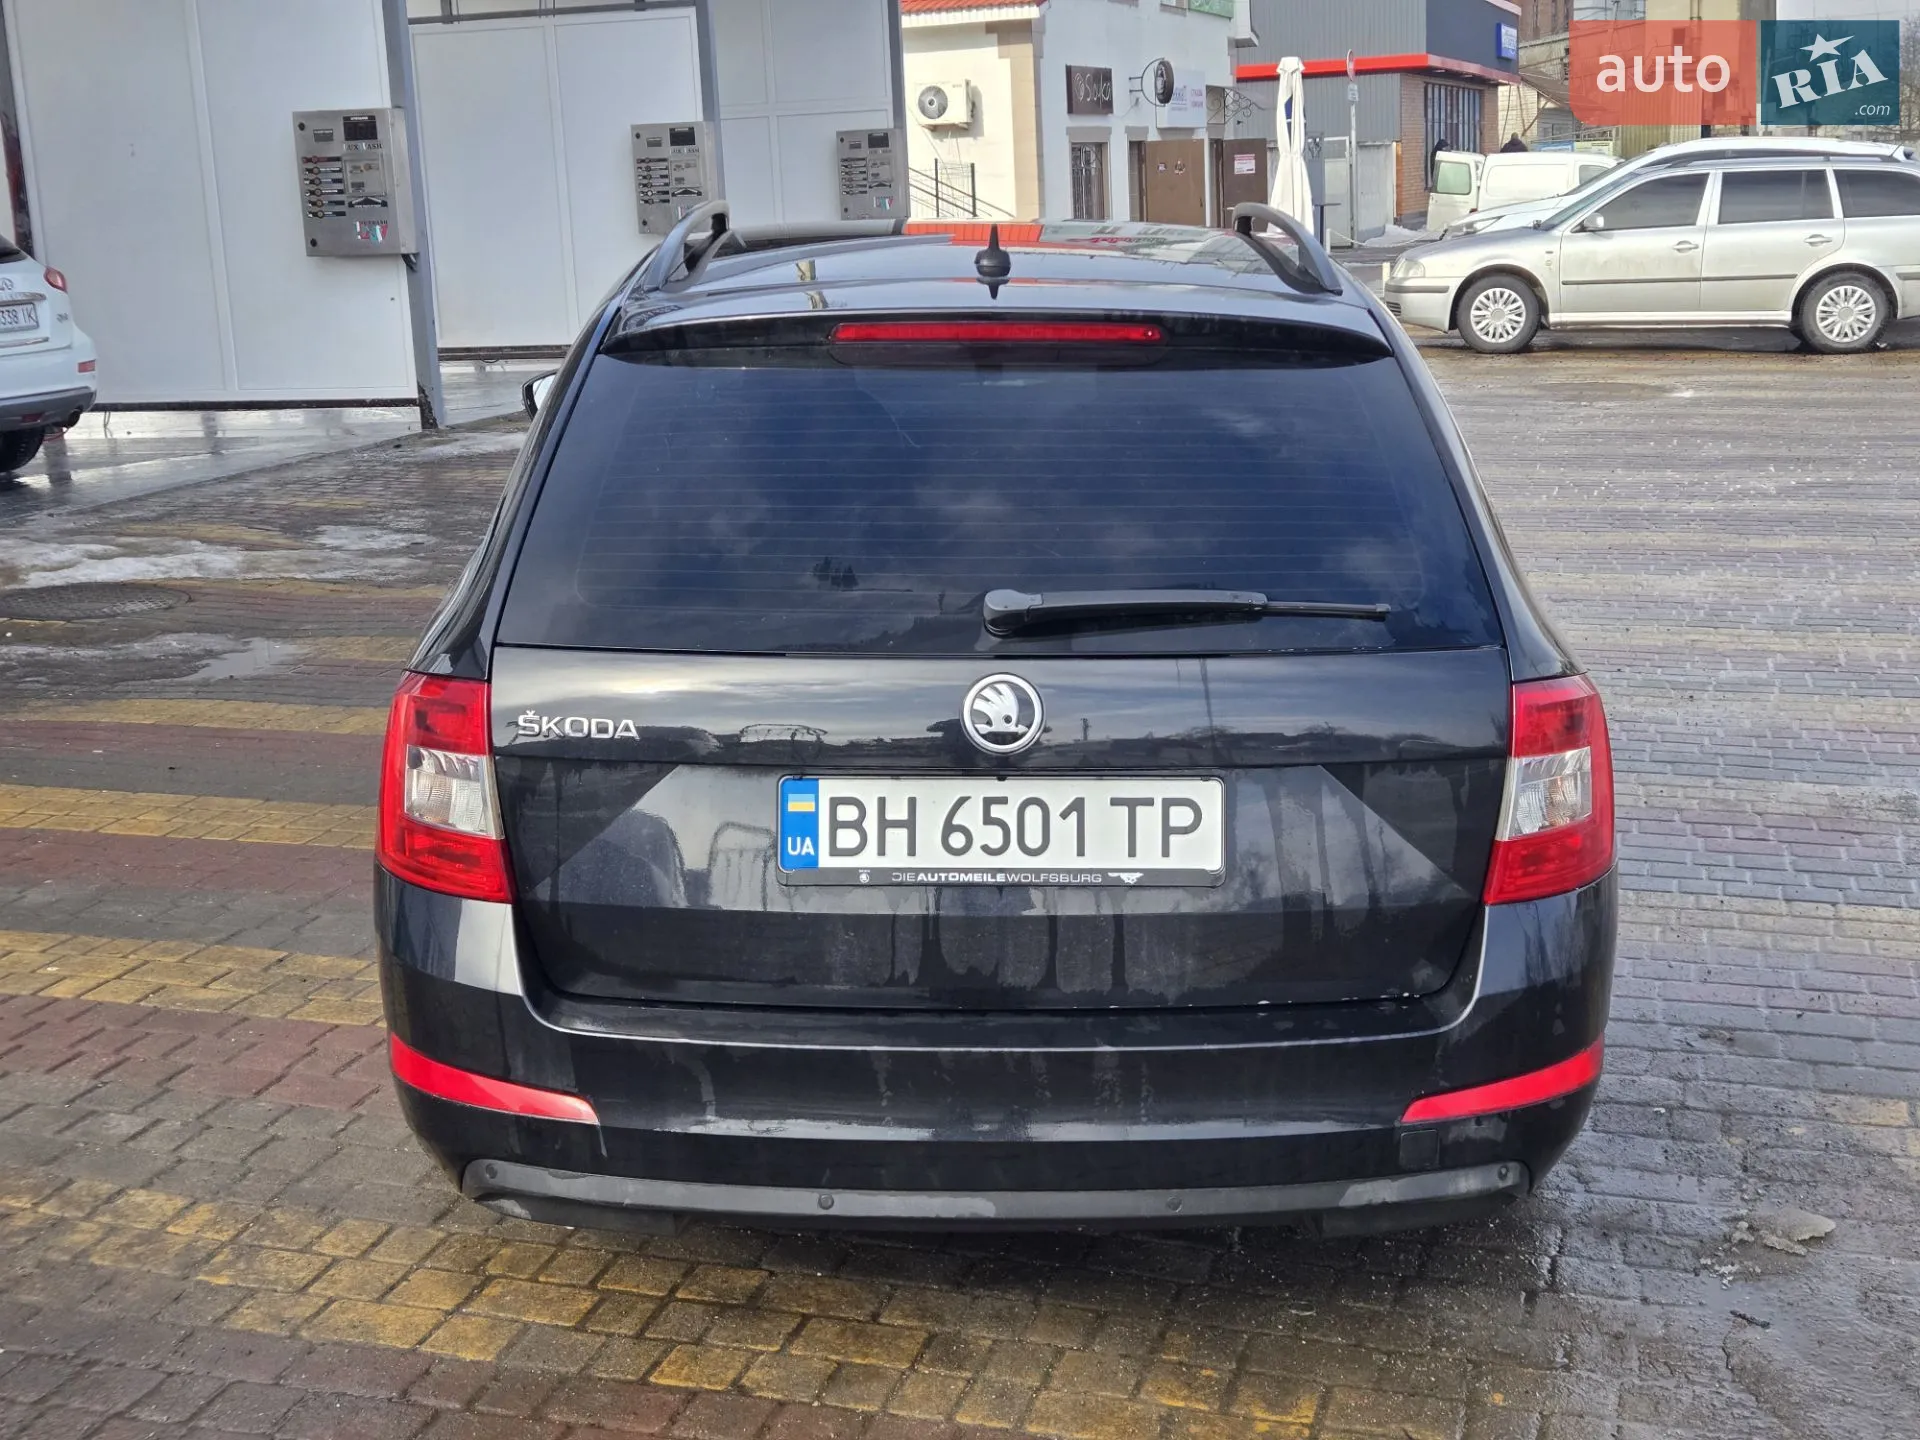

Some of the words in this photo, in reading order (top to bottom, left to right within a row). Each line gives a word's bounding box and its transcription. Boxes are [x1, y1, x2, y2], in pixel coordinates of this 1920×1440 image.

[518, 710, 640, 741] ŠKODA
[828, 796, 917, 857] BH
[941, 796, 1086, 858] 6501
[1110, 796, 1203, 858] TP
[788, 836, 815, 856] UA
